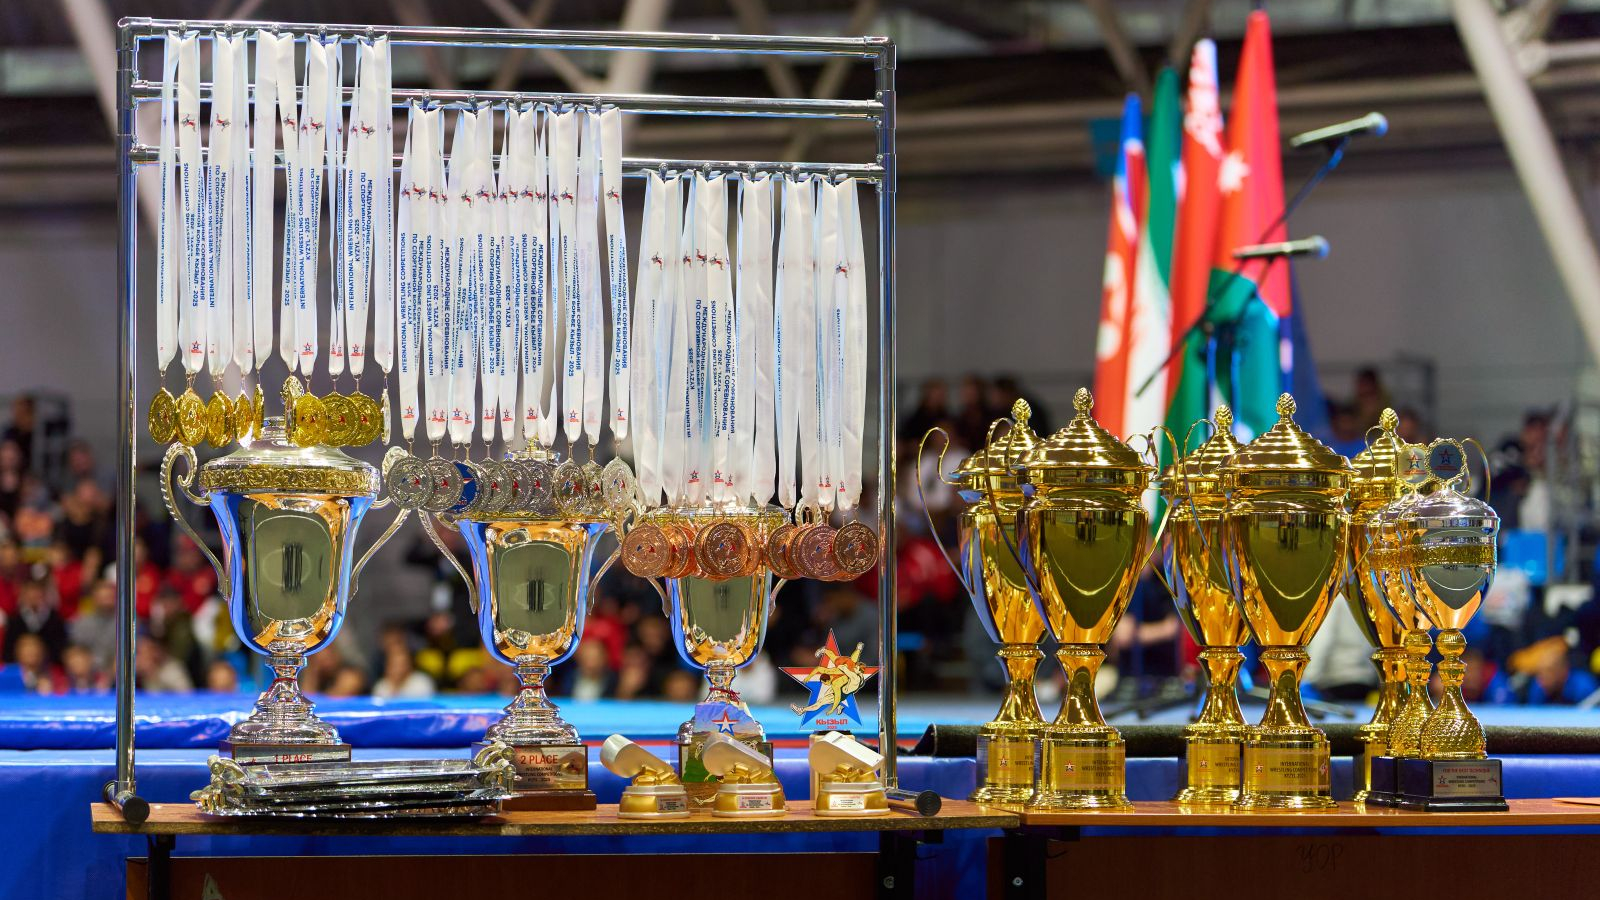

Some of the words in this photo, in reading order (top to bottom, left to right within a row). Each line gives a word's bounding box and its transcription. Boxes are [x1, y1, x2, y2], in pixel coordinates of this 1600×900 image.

[215, 165, 220, 175] ПО
[311, 168, 315, 178] ПО
[360, 172, 366, 183] ПО
[412, 233, 418, 243] ПО
[490, 236, 495, 247] ПО
[532, 236, 537, 247] ПО
[696, 299, 701, 310] ПО
[520, 755, 526, 765] 2
[530, 754, 558, 765] PLACE
